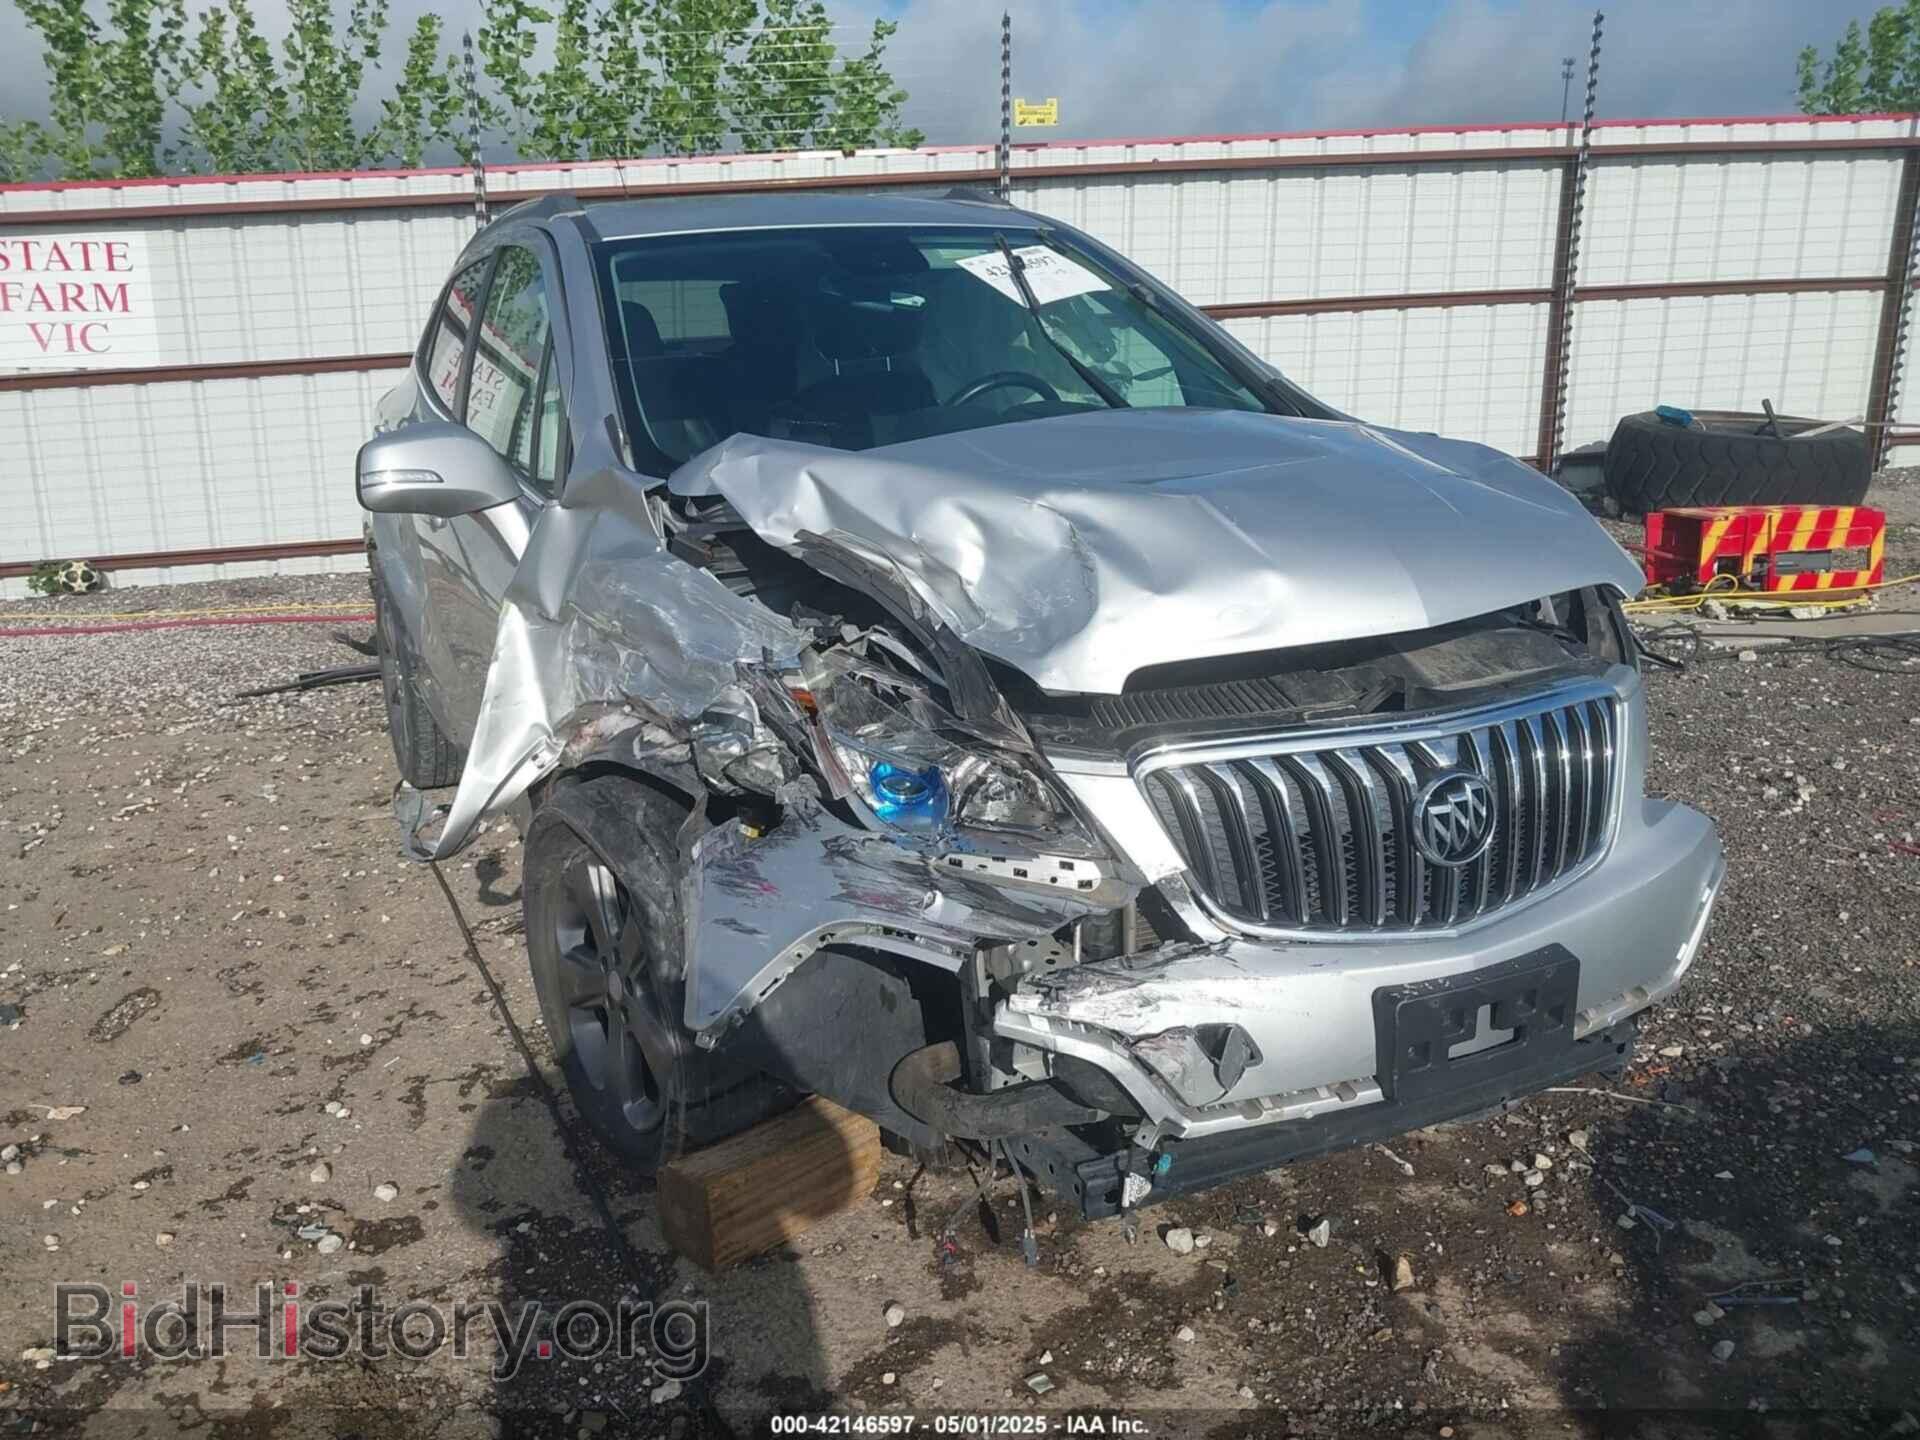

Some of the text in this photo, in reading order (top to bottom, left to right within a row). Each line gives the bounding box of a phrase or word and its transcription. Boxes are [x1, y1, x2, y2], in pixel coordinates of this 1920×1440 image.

[0, 240, 134, 272] STATE
[0, 282, 131, 312] FARM
[27, 322, 112, 353] VIC
